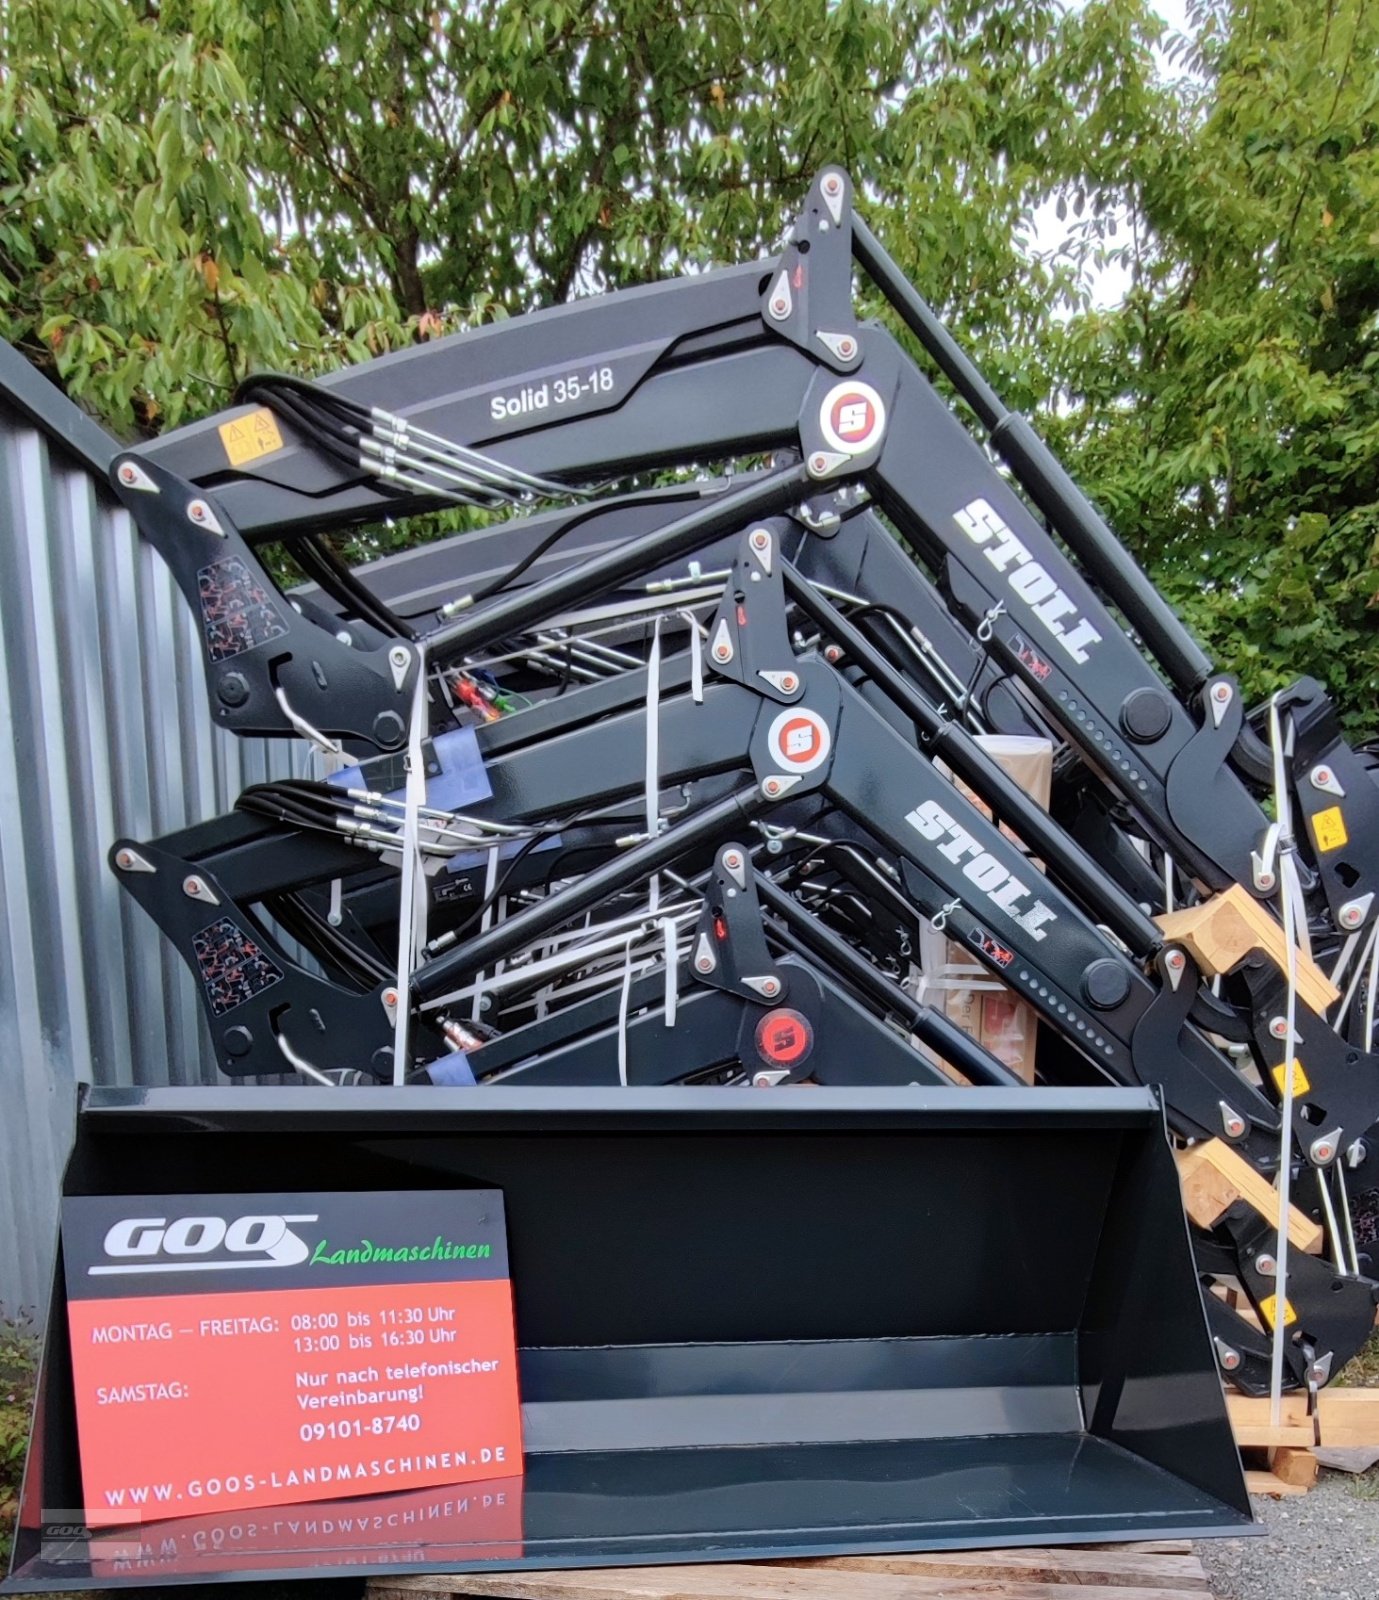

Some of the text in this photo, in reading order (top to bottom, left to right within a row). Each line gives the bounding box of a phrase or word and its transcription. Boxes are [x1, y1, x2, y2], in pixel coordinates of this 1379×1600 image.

[491, 367, 614, 420] Solid 35-18
[952, 498, 1103, 665] STOLL
[904, 800, 1058, 942] STOLL
[88, 1214, 319, 1275] GOOS
[309, 1235, 491, 1267] Landmaschinen
[92, 1322, 173, 1344] MONTAG
[199, 1316, 280, 1337] FREITAG:
[291, 1312, 339, 1331] 08:00
[347, 1312, 371, 1328] bis
[379, 1308, 423, 1326] 11:30
[428, 1307, 456, 1322] Uhr
[294, 1328, 457, 1353] 13:00 bis 16:30 Uhr
[296, 1357, 500, 1388] Nur nach telefonischer
[96, 1381, 190, 1405] SAMSTAG:
[296, 1384, 424, 1410] Vereinbarung!
[300, 1413, 421, 1442] 09101-8740
[104, 1446, 506, 1506] WWW.GOOS-LANDMASCHINEN.DE
